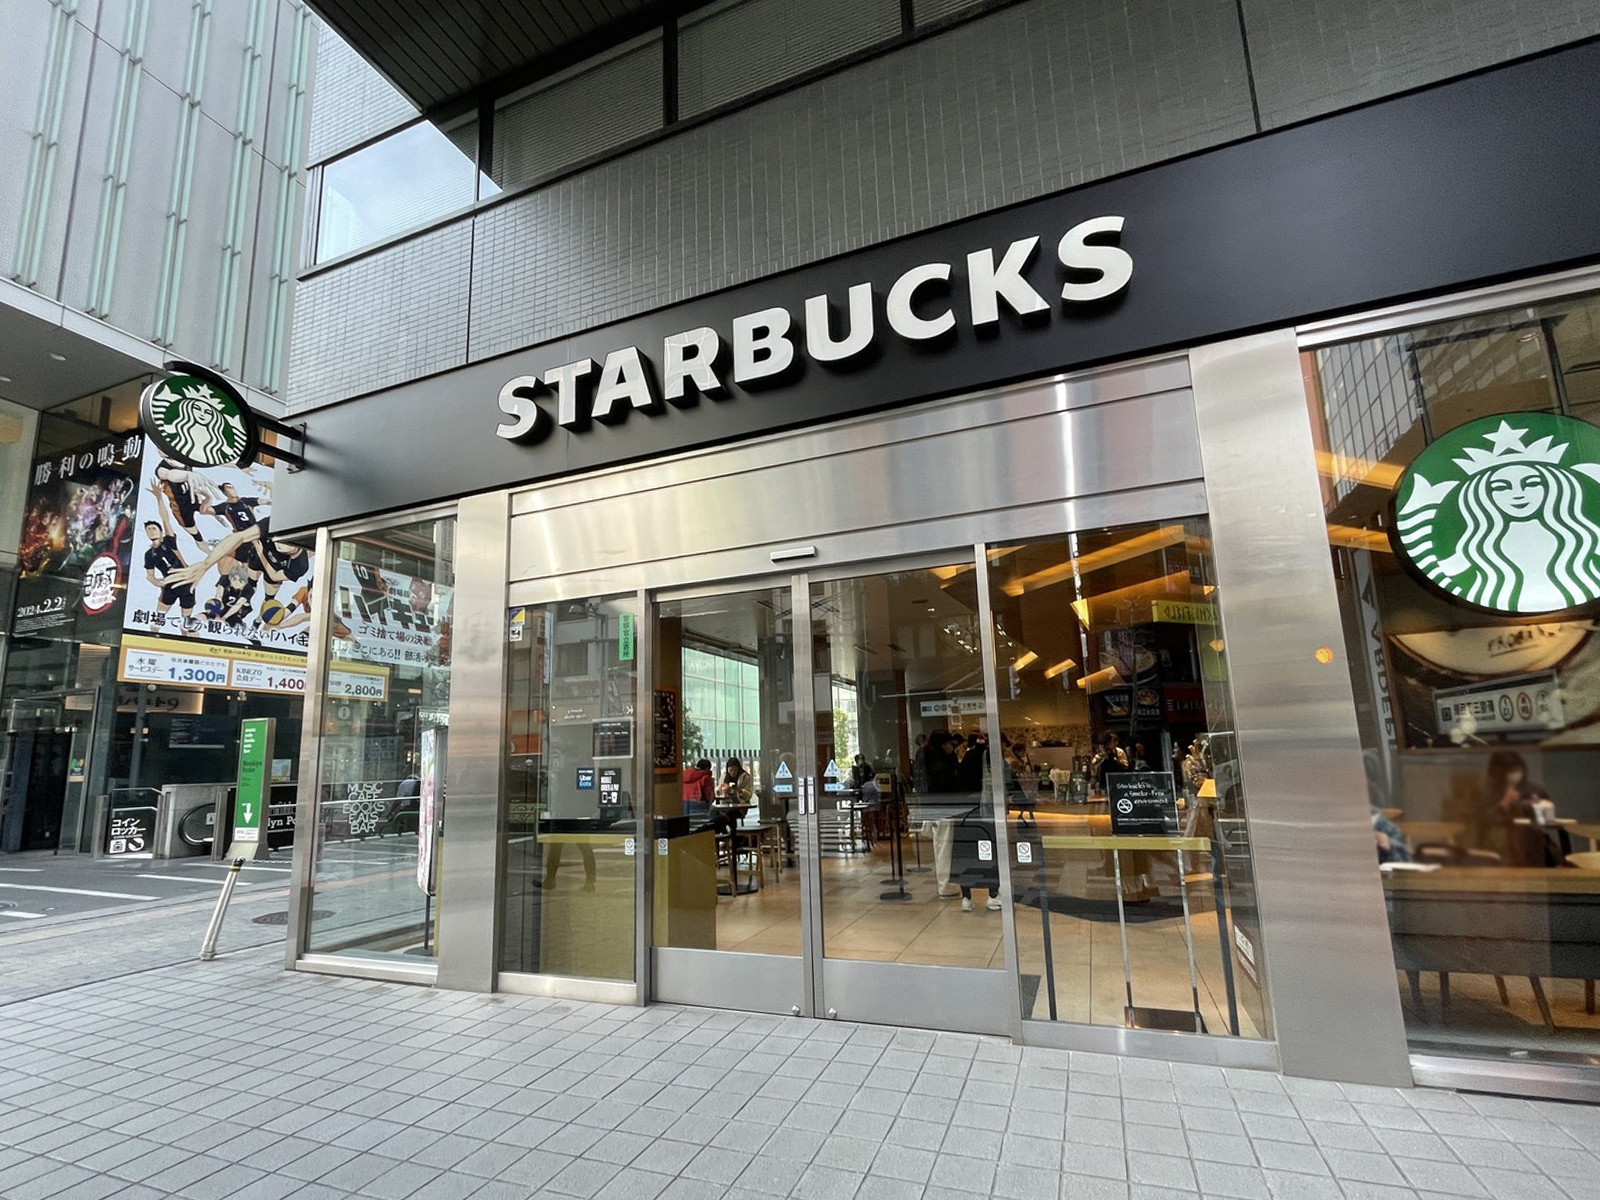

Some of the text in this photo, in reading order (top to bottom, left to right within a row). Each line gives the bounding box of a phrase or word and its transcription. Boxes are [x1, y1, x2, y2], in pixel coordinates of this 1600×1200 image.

[496, 216, 1134, 439] STARBUCKS
[238, 511, 249, 522] 3
[162, 557, 171, 567] 1
[355, 564, 369, 580] 10
[17, 597, 63, 618] 2024.2.2
[168, 667, 226, 683] 1,300円
[267, 677, 307, 691] 1,400
[344, 684, 382, 697] 2,800円
[347, 781, 383, 793] MUSIC
[343, 801, 385, 814] BOOKS
[112, 818, 141, 827] コイン
[349, 812, 379, 824] EATS
[111, 827, 147, 836] ロッカー
[351, 822, 376, 834] BAR
